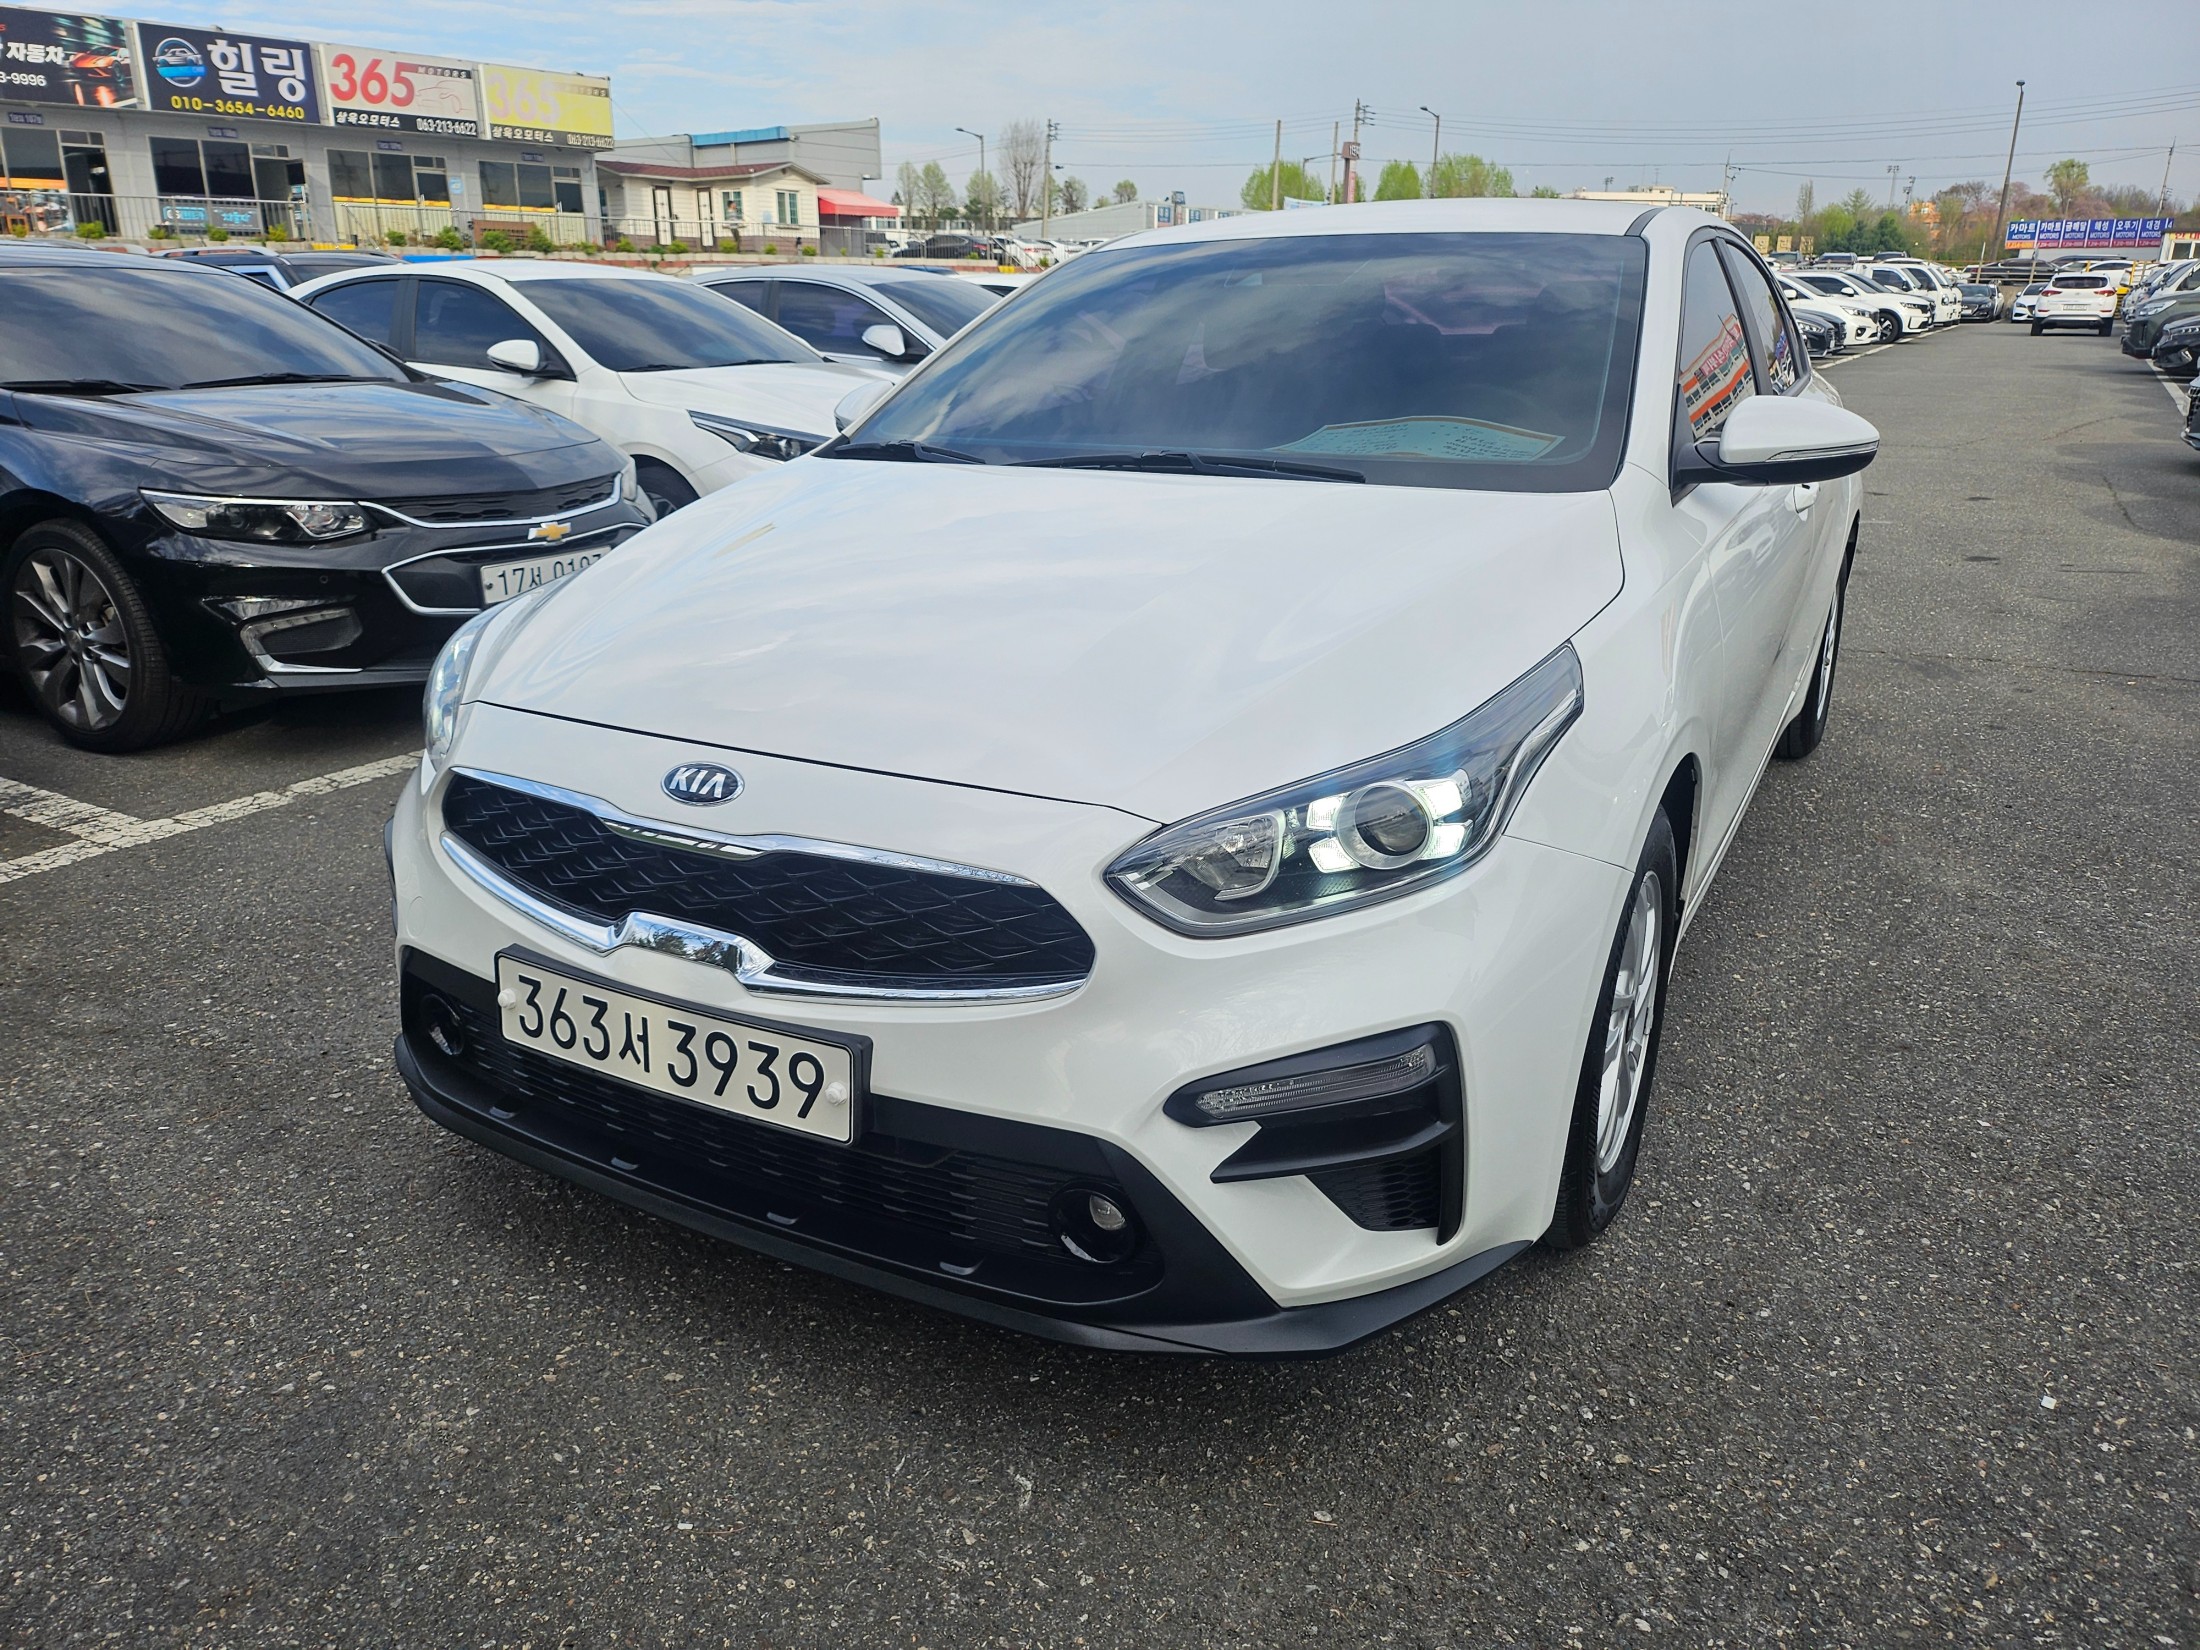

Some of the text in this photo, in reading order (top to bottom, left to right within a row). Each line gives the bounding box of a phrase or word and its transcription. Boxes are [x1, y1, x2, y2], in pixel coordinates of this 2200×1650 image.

[6, 42, 65, 66] 자동차
[206, 39, 306, 102] 힐링
[330, 53, 415, 107] 365
[416, 64, 467, 79] MOTORS
[171, 95, 305, 120] 010-3654-6460
[486, 73, 560, 124] 365
[336, 111, 400, 128] 삼육오모터스
[416, 117, 477, 136] 063-213-6622
[2010, 222, 2036, 233] 카마트
[2040, 221, 2062, 232] 카마트
[2116, 220, 2138, 231] 오뚜기
[669, 767, 727, 799] KIA
